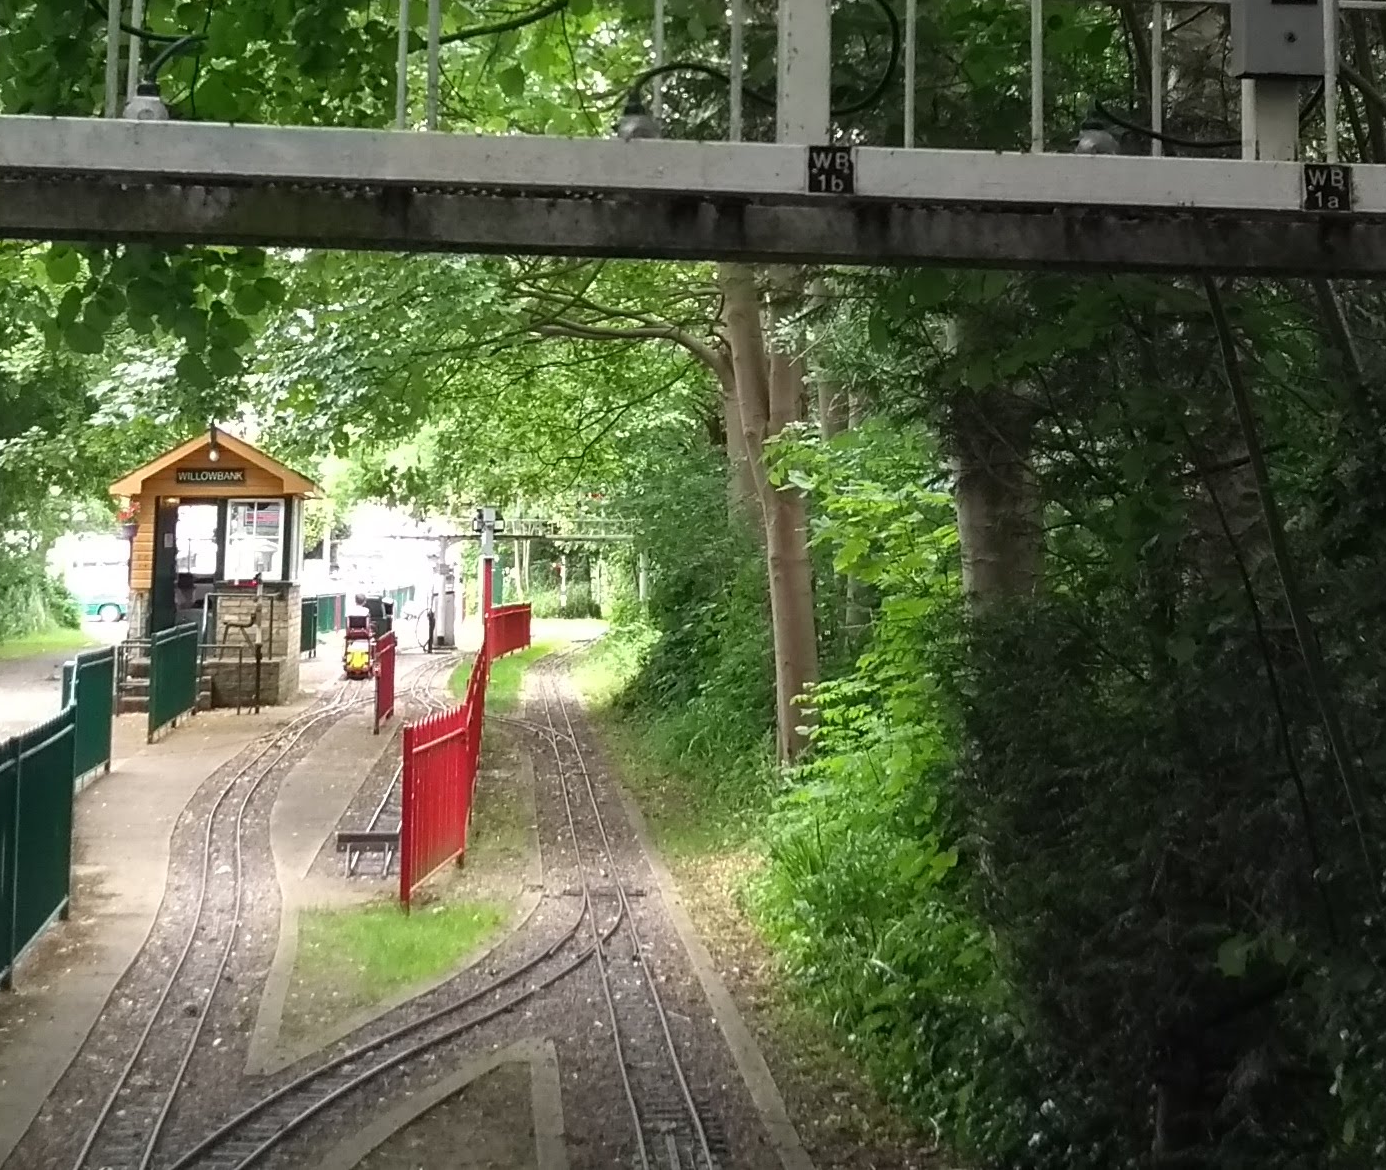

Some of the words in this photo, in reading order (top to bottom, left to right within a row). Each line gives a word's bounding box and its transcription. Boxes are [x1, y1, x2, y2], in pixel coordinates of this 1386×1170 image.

[812, 152, 850, 170] WB
[818, 174, 844, 192] 1b
[1307, 169, 1344, 187] WB
[1314, 191, 1340, 209] 1a
[177, 471, 243, 481] WILLOWBANK
